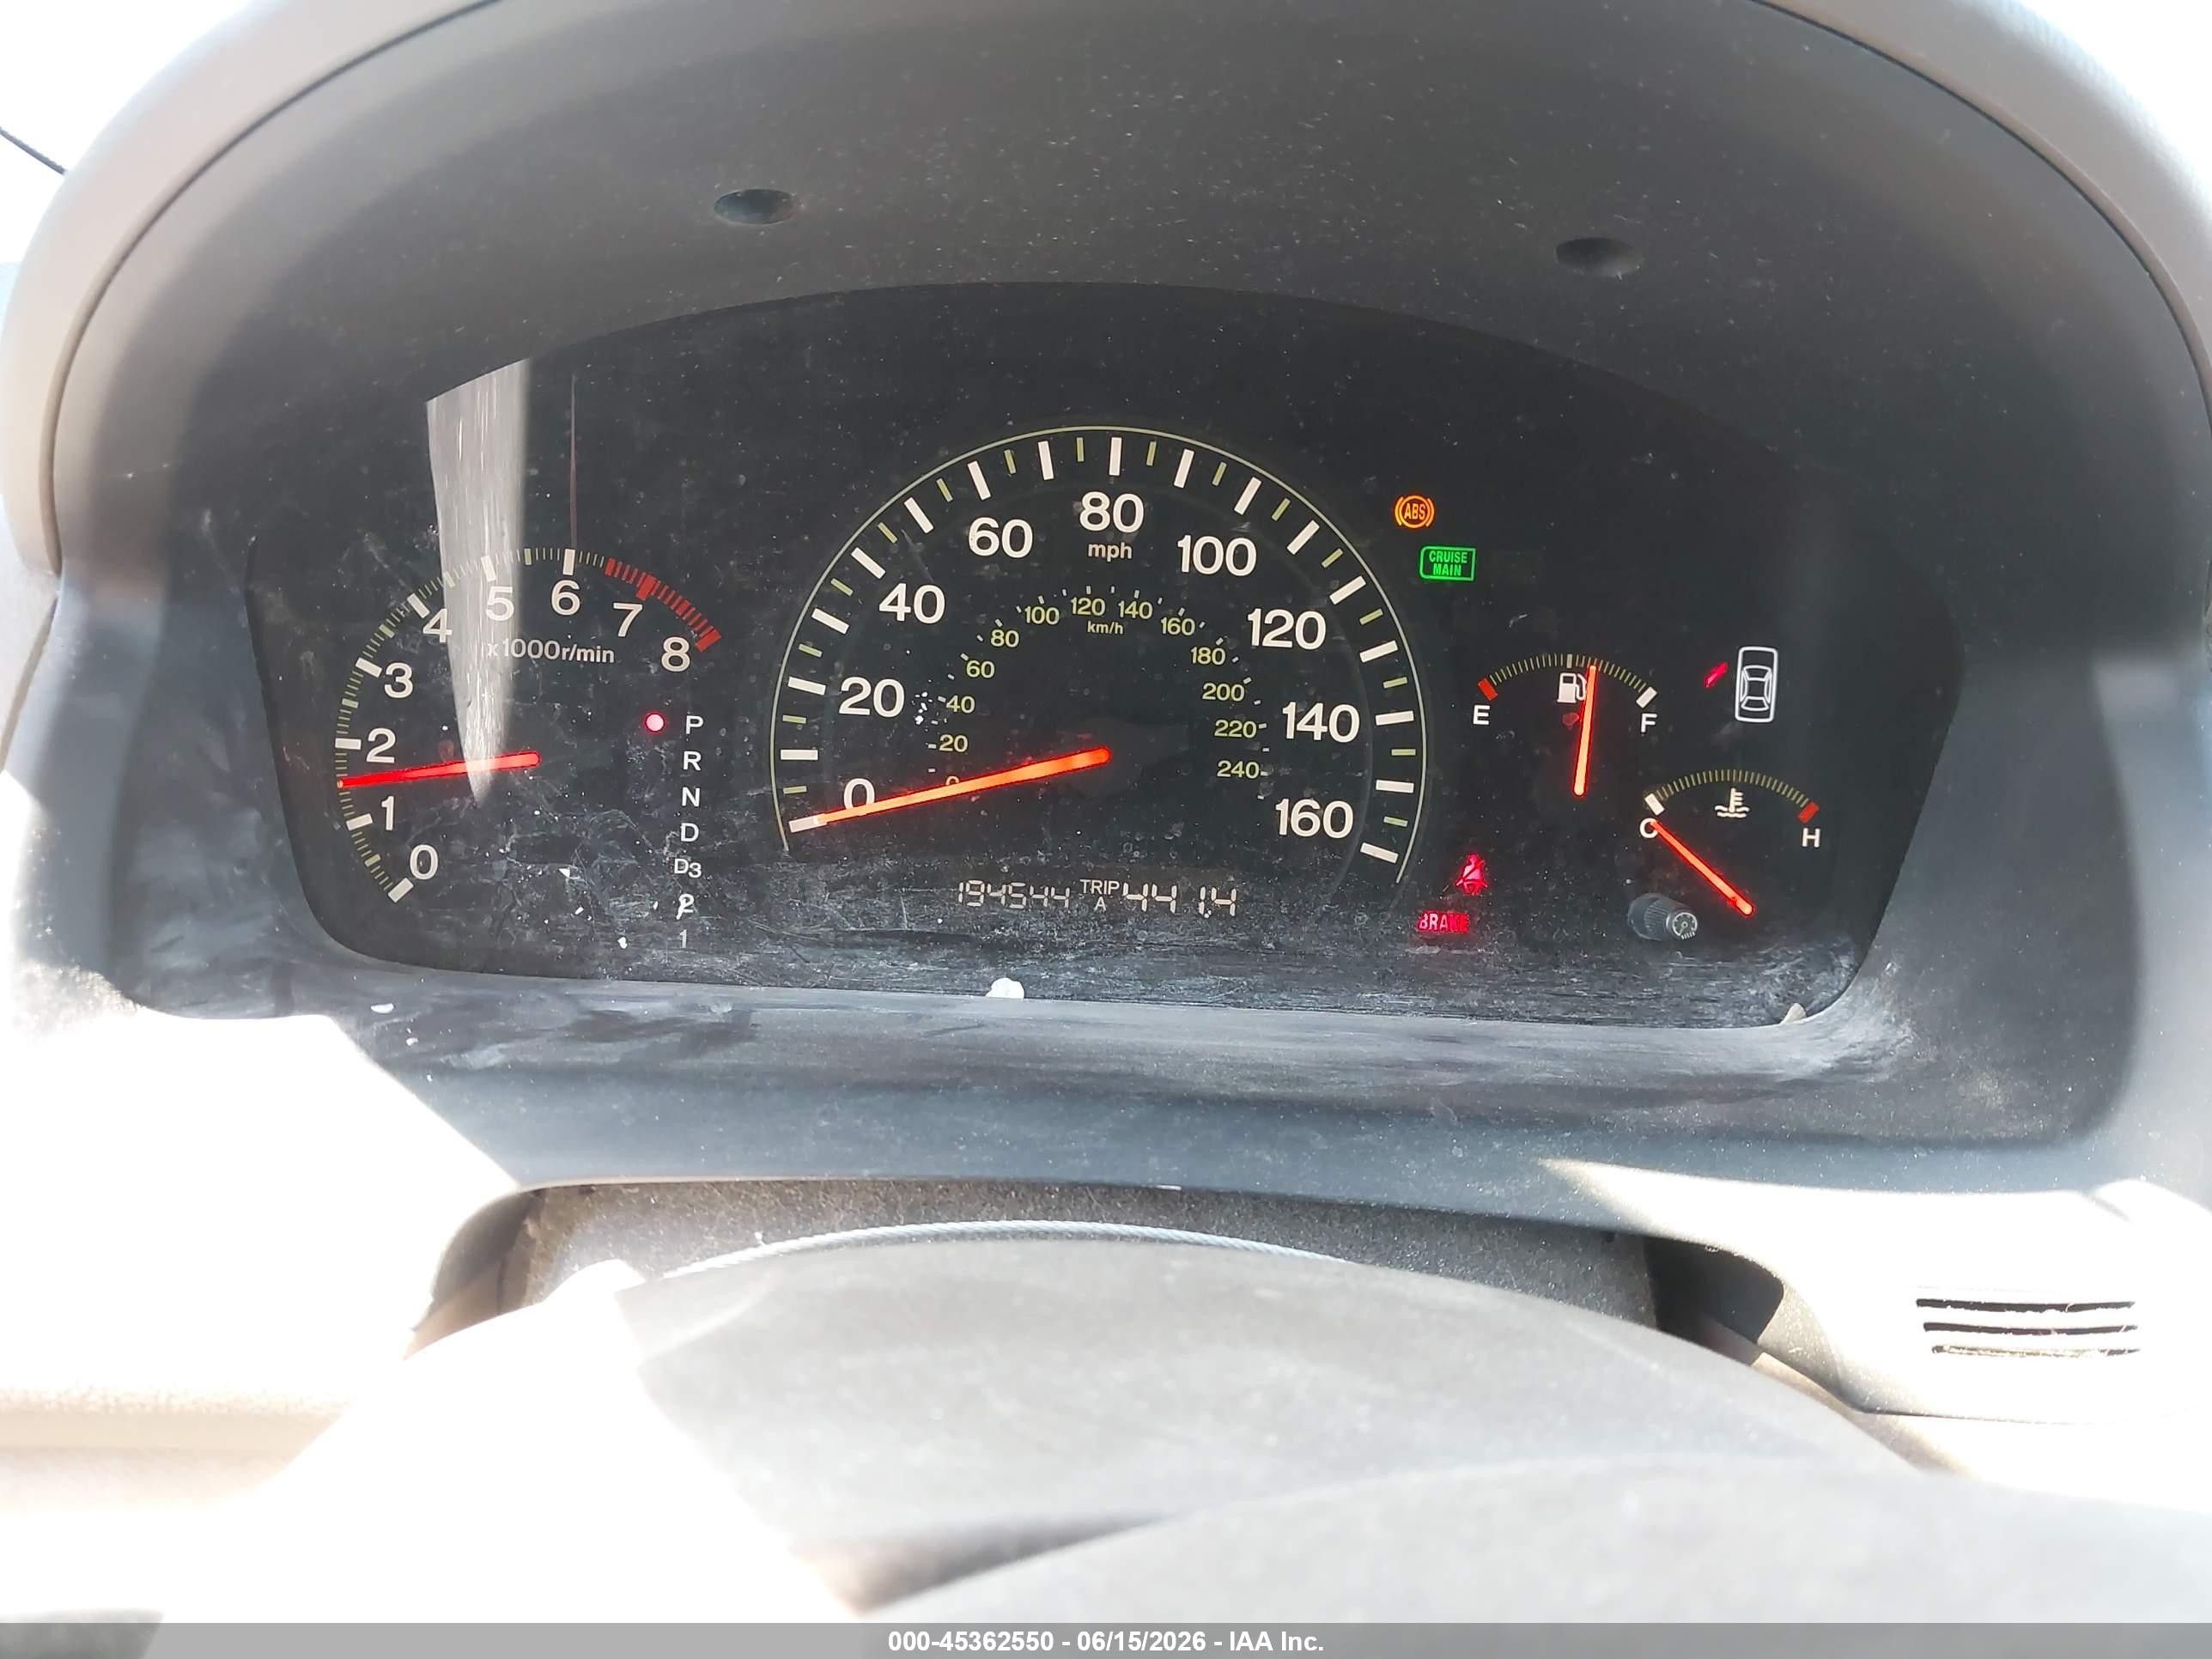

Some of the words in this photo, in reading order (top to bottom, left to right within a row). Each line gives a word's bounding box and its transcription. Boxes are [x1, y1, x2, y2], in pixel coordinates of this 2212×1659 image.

[1080, 492, 1144, 532] 80
[1404, 503, 1425, 520] ABS
[969, 518, 1032, 557] 60
[1089, 542, 1132, 562] mph
[1178, 535, 1256, 575] 100
[1429, 550, 1467, 562] CRUISE
[1433, 563, 1461, 575] MAIN
[485, 586, 514, 621] 5
[552, 580, 580, 616] 6
[879, 583, 945, 623] 40
[1071, 598, 1105, 616] 120
[614, 603, 642, 636] 7
[1025, 606, 1060, 624] 100
[1119, 602, 1153, 619] 140
[422, 608, 453, 643] 4
[1088, 621, 1122, 634] km/h
[1161, 617, 1195, 635] 160
[1248, 609, 1326, 649] 120
[991, 629, 1018, 647] 80
[662, 637, 690, 672] 8
[1191, 647, 1226, 665] 180
[966, 660, 995, 678] 60
[384, 663, 412, 698] 3
[839, 677, 904, 717] 20
[1202, 684, 1245, 702] 200
[946, 696, 975, 713] 40
[686, 715, 703, 734] P
[1283, 702, 1359, 742] 140
[1474, 705, 1490, 725] E
[1641, 714, 1657, 732] F
[1214, 720, 1256, 738] 220
[367, 728, 395, 763] 2
[939, 735, 968, 751] 20
[684, 751, 701, 770] R
[1218, 761, 1259, 778] 240
[682, 787, 700, 806] N
[843, 778, 876, 810] 0
[382, 796, 393, 830] 1
[1276, 799, 1352, 838] 160
[680, 823, 699, 842] D
[1640, 818, 1659, 838] C
[1802, 828, 1820, 847] H
[410, 845, 439, 881] 0
[958, 879, 1070, 909] 194544
[1080, 879, 1119, 895] TRIP
[1094, 896, 1106, 912] A
[680, 930, 686, 948] 1
